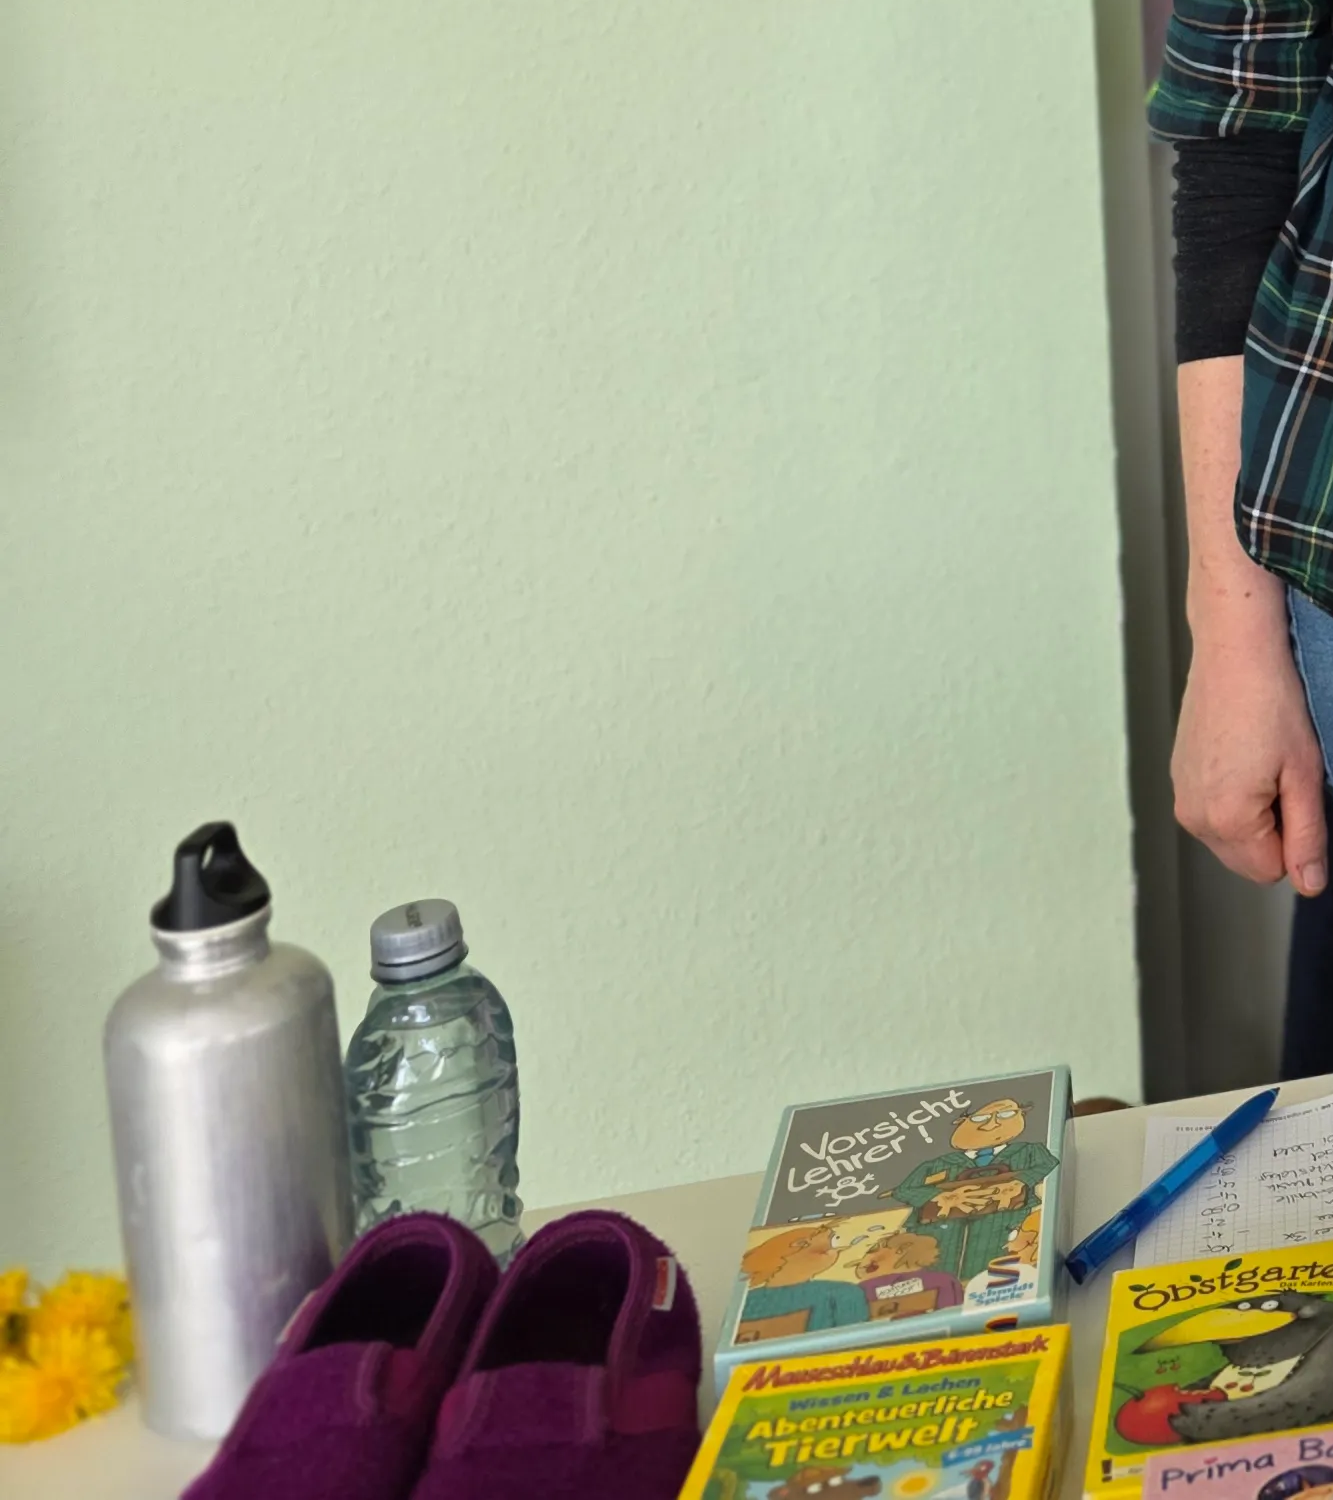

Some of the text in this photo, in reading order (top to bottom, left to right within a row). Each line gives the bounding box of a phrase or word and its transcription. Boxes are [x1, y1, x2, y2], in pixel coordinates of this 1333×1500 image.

[800, 1089, 971, 1160] Vorsicht
[788, 1135, 906, 1193] Lehrer
[742, 1354, 898, 1393] Mauseschlau
[789, 1375, 982, 1413] Wissen & Lachen
[746, 1388, 1014, 1441] Abenteuerliche
[764, 1415, 979, 1469] Tierwelt
[1161, 1452, 1275, 1491] Prima
